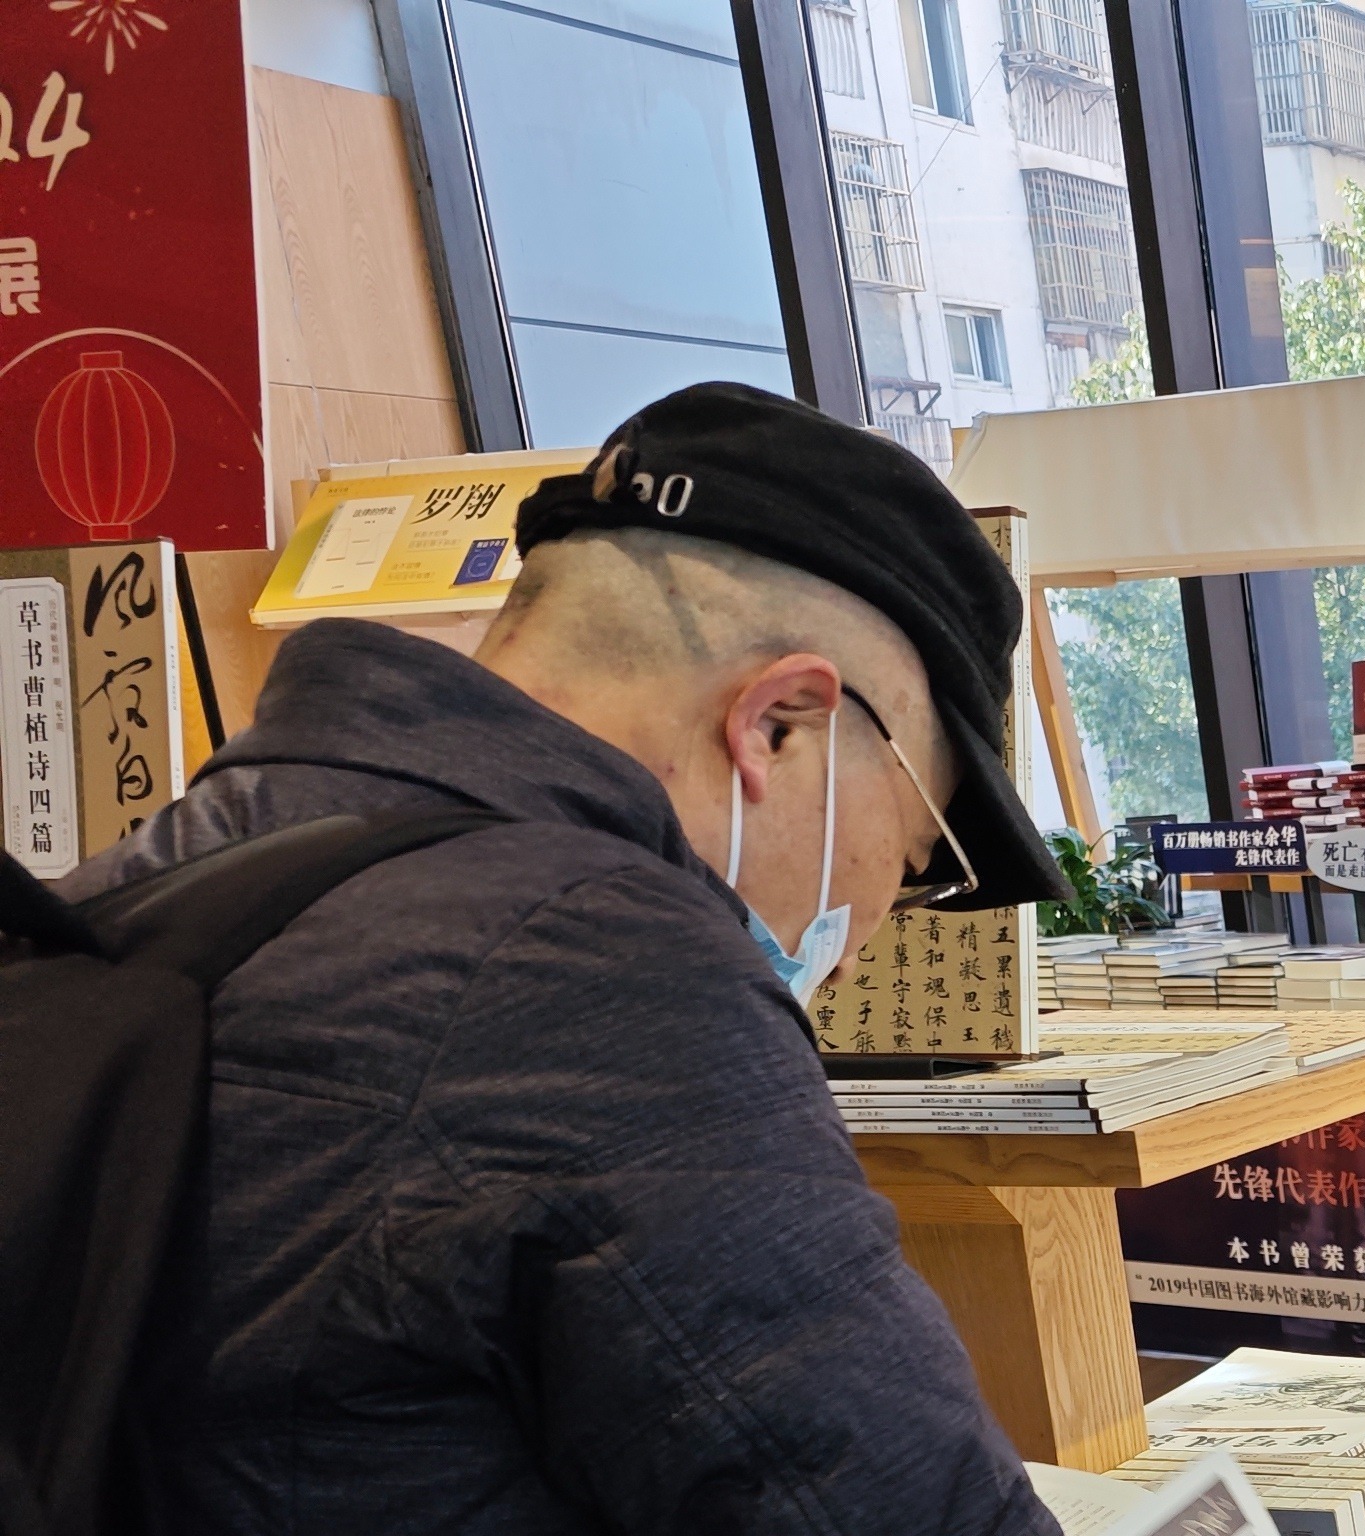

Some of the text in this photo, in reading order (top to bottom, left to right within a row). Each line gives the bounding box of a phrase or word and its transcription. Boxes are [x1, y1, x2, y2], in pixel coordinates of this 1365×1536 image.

[410, 483, 506, 525] 罗翔
[17, 600, 53, 854] 草书曹植诗四篇
[1161, 825, 1298, 852] 百万册畅销书作家余华
[1235, 848, 1300, 867] 先锋代表作
